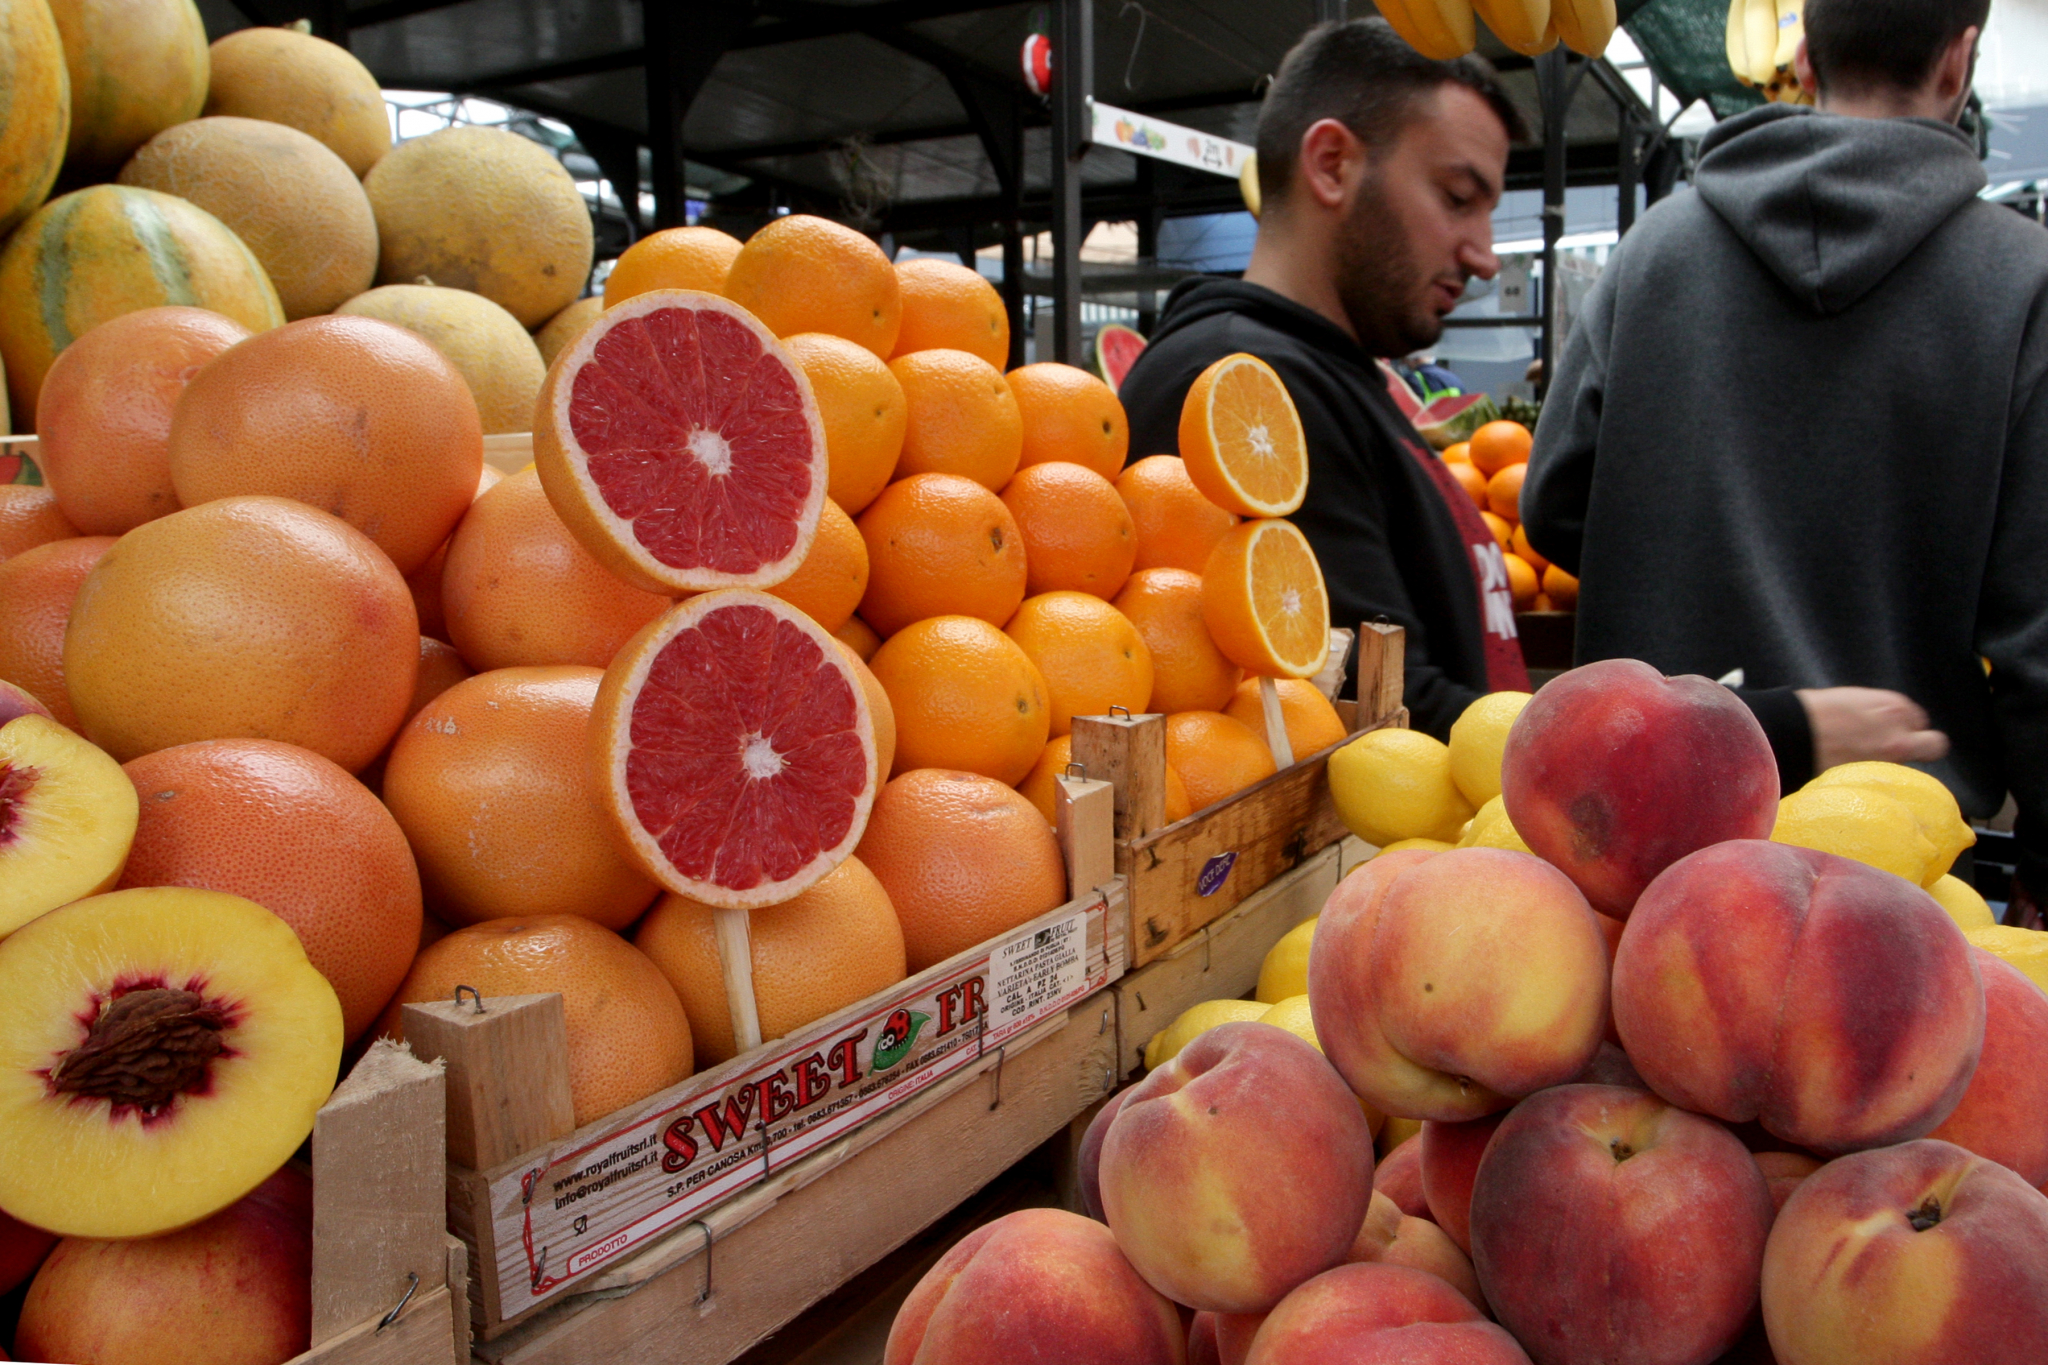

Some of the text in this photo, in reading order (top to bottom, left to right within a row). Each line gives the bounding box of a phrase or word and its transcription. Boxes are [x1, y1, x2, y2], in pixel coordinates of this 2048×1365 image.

[1002, 918, 1076, 959] SWEET FRUIT
[997, 947, 1076, 988] NETTARINA PASTA GIALLA
[1026, 986, 1032, 994] A
[1037, 978, 1046, 989] PZ
[1049, 973, 1058, 982] 24
[1033, 965, 1055, 981] EARLY
[1000, 997, 1024, 1014] ORIGINE
[1028, 987, 1047, 1000] ITALIA
[662, 1028, 868, 1174] SWEET
[667, 1182, 685, 1198] S.P.
[686, 1170, 706, 1188] PER
[707, 1151, 746, 1177] CANOSA
[793, 1119, 806, 1132] tel.
[905, 1060, 920, 1073] FAX
[553, 1133, 657, 1192] www.royalfruitsrl.it
[554, 1151, 658, 1210] info@royalfruitsrl.it
[578, 1234, 628, 1266] PRODOTTO
[915, 1070, 934, 1088] ITALIA
